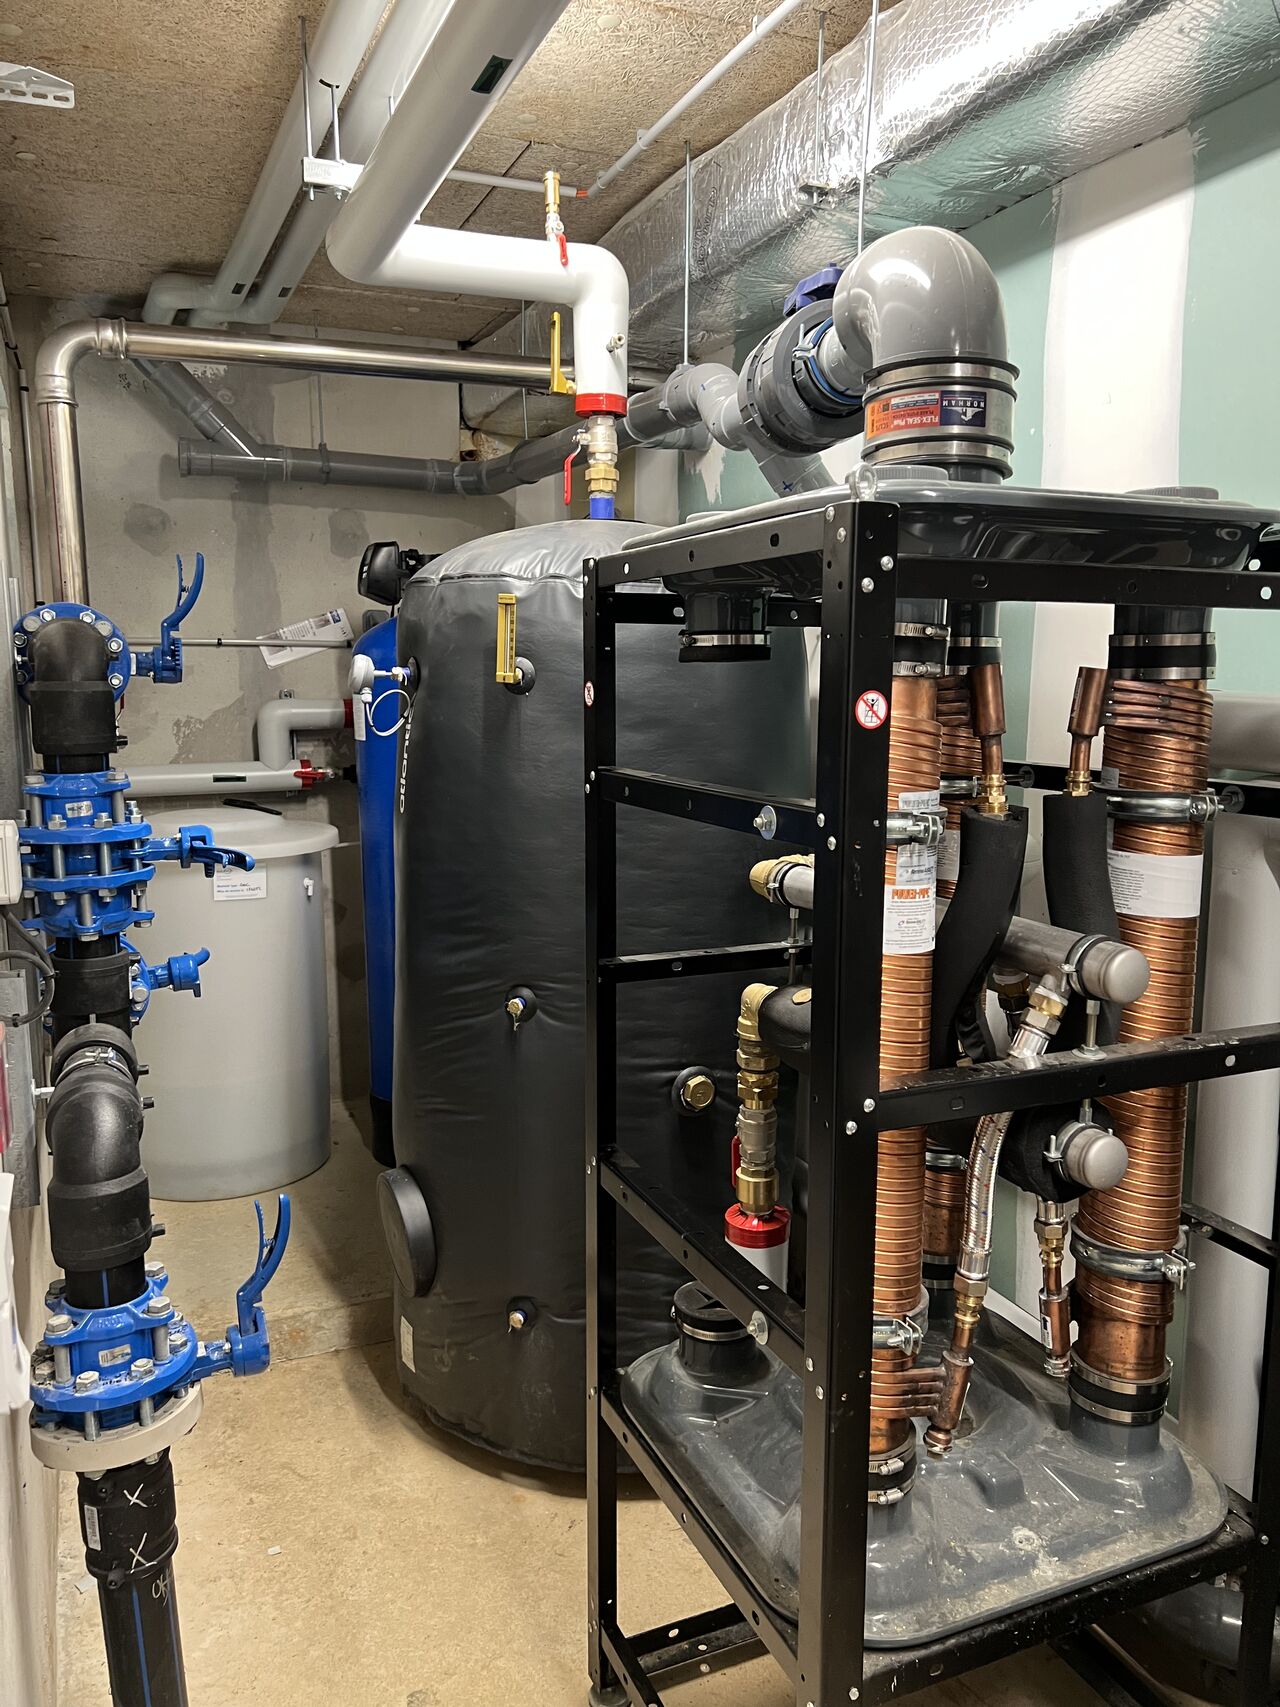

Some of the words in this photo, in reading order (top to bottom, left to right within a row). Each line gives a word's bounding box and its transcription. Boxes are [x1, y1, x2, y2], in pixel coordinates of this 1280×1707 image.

[942, 400, 985, 408] NORHAM
[906, 415, 939, 425] FLEX-SEAL
[399, 706, 415, 814] atlantic
